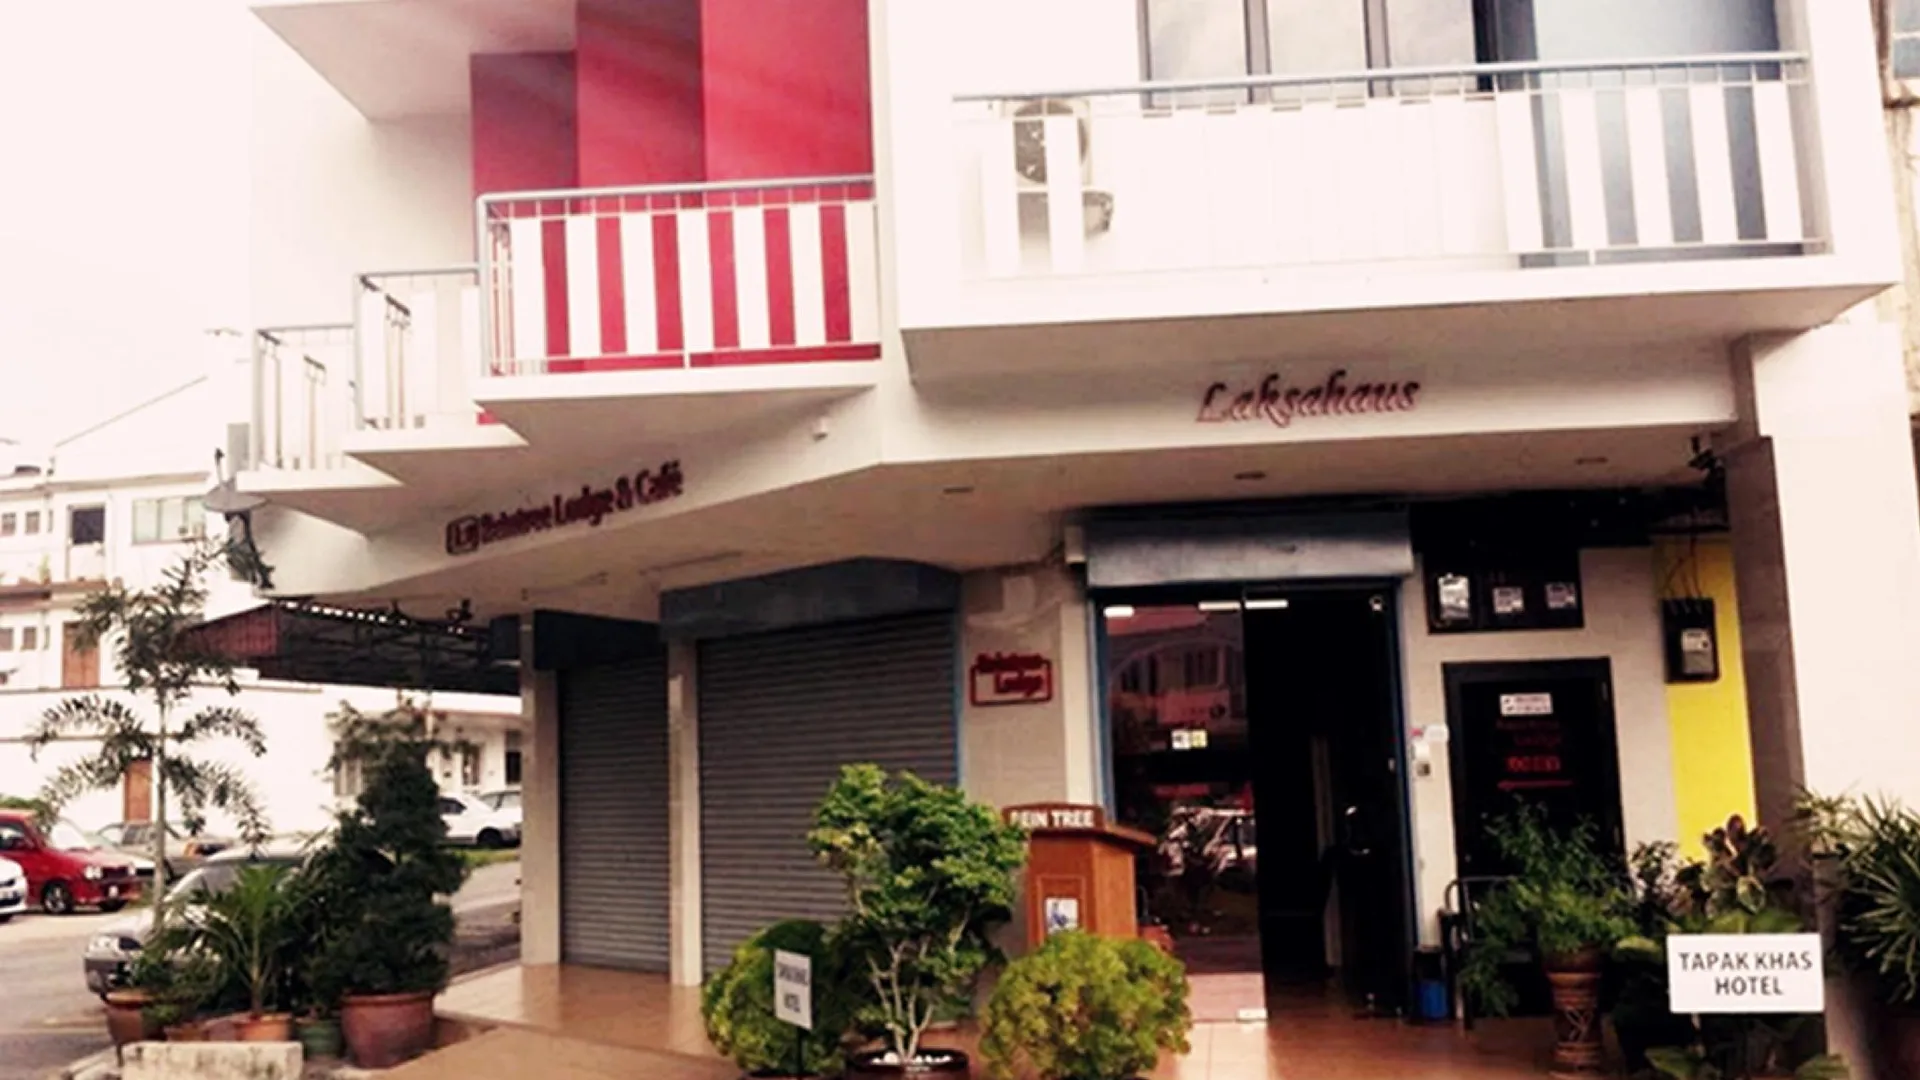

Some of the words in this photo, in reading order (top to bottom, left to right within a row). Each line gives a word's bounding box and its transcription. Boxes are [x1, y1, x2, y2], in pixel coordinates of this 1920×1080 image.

[1196, 368, 1421, 428] Laksahaus
[553, 485, 613, 527] Lodge
[616, 476, 633, 510] &
[1051, 809, 1094, 828] TREE
[1678, 952, 1750, 971] TAPAK
[1754, 951, 1813, 970] KHAS
[1714, 976, 1784, 996] HOTEL
